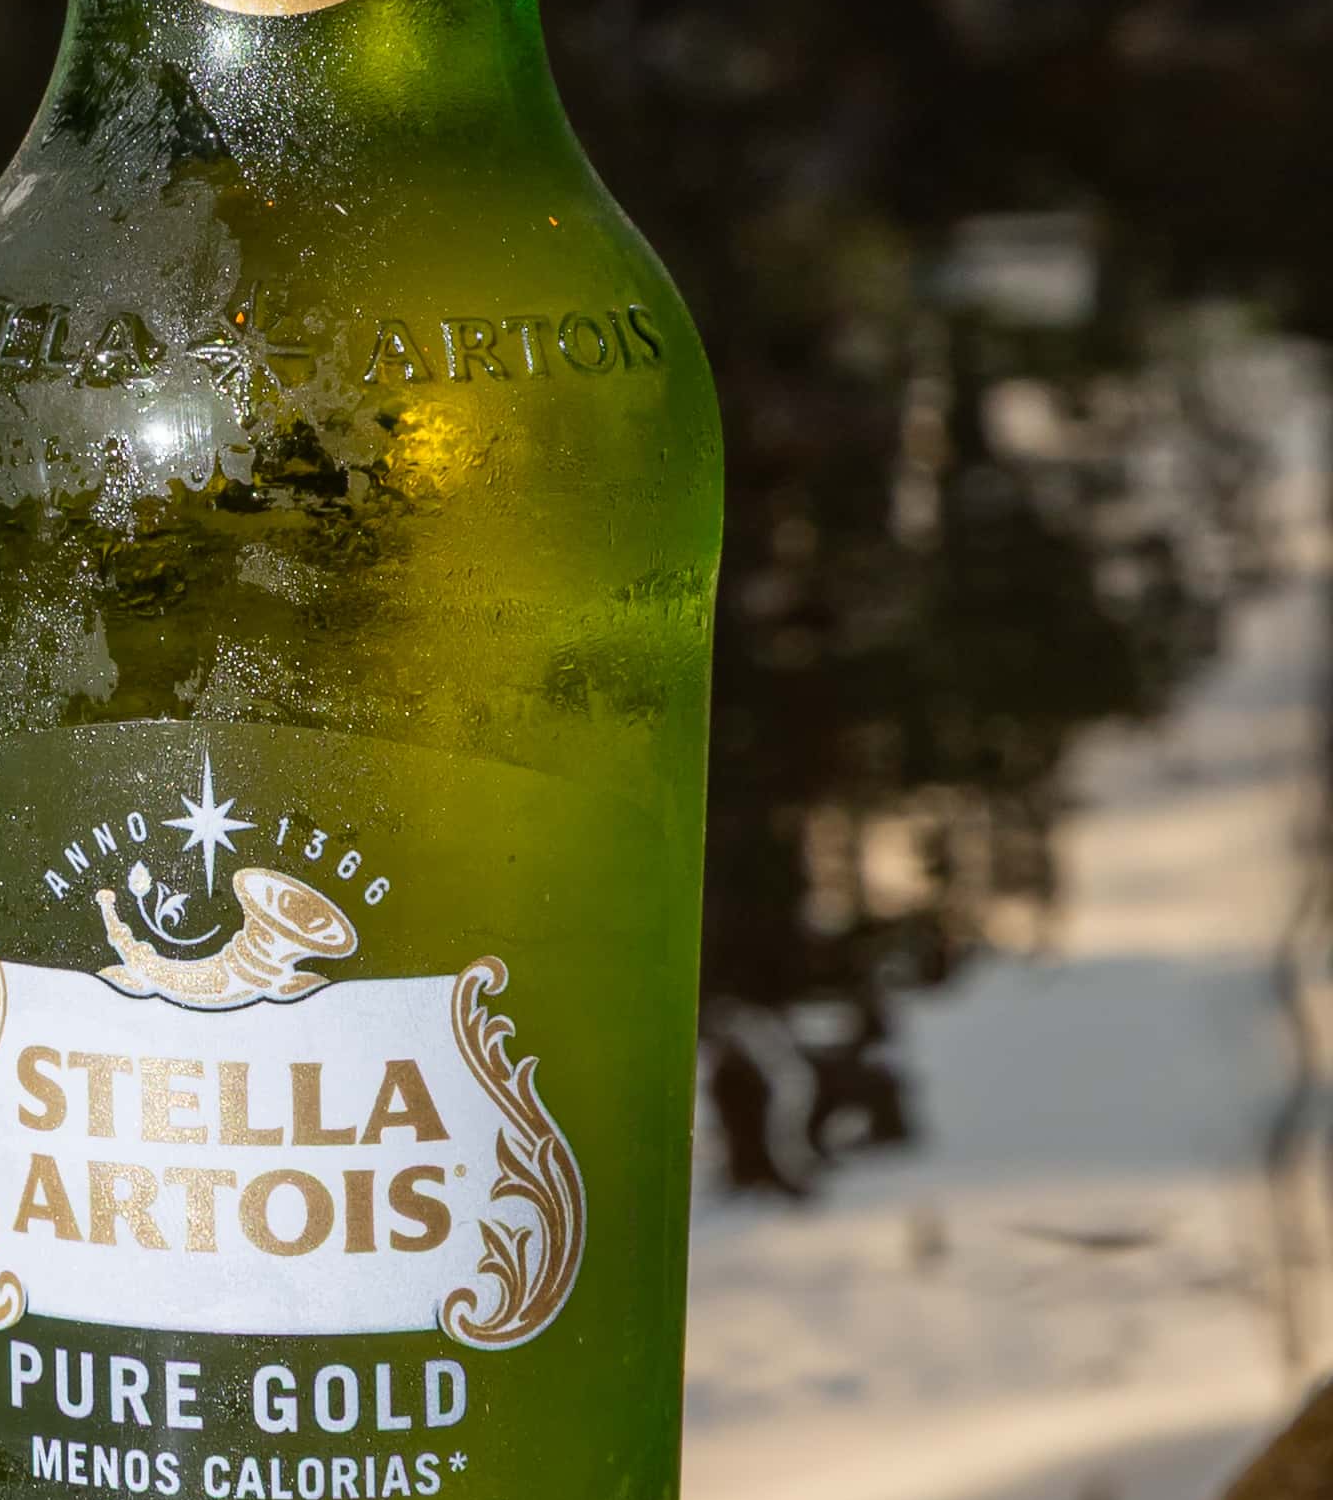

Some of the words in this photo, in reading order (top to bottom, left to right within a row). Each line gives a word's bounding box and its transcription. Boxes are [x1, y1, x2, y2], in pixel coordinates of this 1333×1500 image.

[363, 304, 662, 384] ARTOIS
[43, 811, 149, 899] ANNO
[275, 816, 391, 906] 1366
[16, 1044, 451, 1147] STELLA
[12, 1152, 453, 1258] ARTOIS
[8, 1338, 205, 1431] PURE
[252, 1359, 469, 1435] GOLD
[31, 1434, 182, 1497] MENOS
